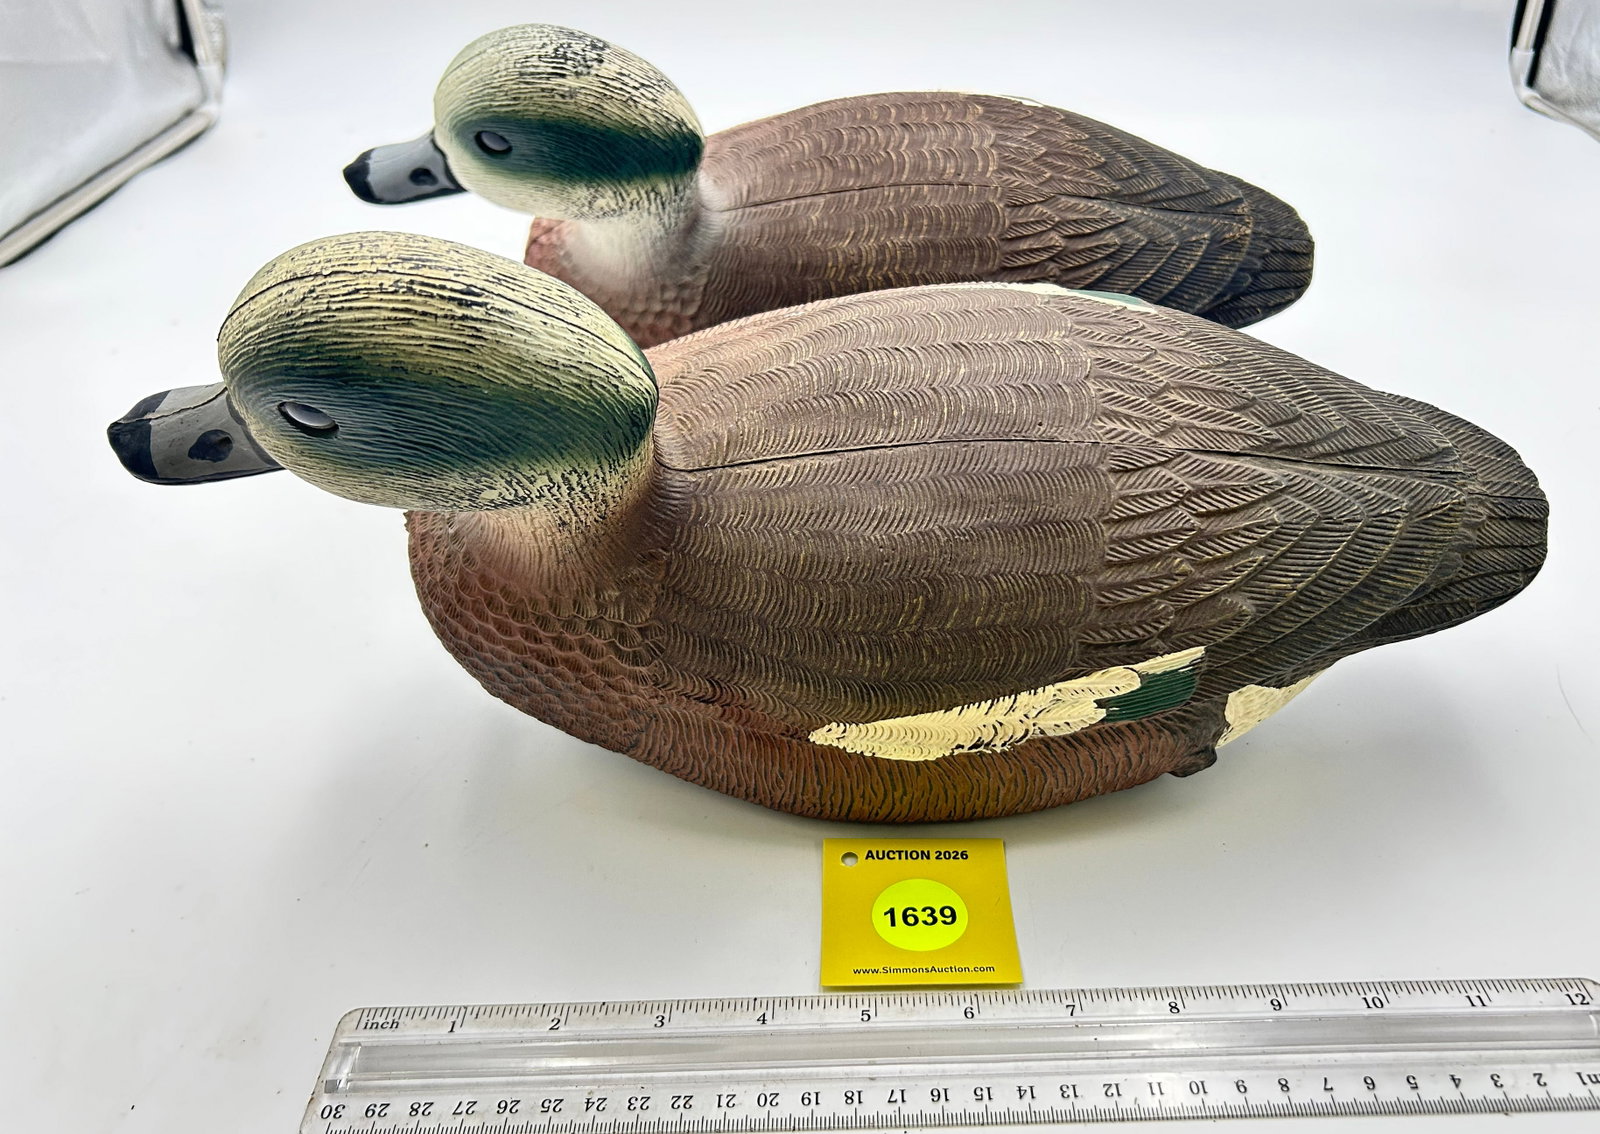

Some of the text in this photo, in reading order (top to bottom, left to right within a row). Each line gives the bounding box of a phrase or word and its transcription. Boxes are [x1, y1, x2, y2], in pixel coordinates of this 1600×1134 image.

[865, 850, 969, 860] AUCTION 2026
[883, 905, 957, 927] 1639
[853, 965, 995, 974] www.SimmonsAuction.com
[363, 993, 1590, 1033] inch 1 2 3 4 5 6 7 8 9 10 11 12
[1235, 1079, 1248, 1094] 9
[1278, 1077, 1290, 1092] 8
[1323, 1077, 1333, 1091] 7
[1363, 1076, 1376, 1090] 6
[1406, 1074, 1419, 1089] 5
[1449, 1074, 1462, 1089] 4
[1490, 1073, 1504, 1088] 3
[1533, 1072, 1547, 1087] 2
[930, 1087, 950, 1102] 16
[973, 1086, 993, 1100] 15
[1016, 1085, 1036, 1100] 14
[1060, 1084, 1079, 1098] 13
[1103, 1083, 1122, 1097] 12
[1149, 1082, 1166, 1096] 11
[1189, 1080, 1208, 1095] 10
[671, 1094, 694, 1109] 22
[716, 1093, 737, 1108] 21
[756, 1092, 779, 1107] 20
[801, 1091, 821, 1106] 19
[844, 1090, 863, 1104] 18
[887, 1088, 907, 1103] 17
[365, 1103, 391, 1117] 29
[409, 1101, 434, 1116] 28
[452, 1100, 478, 1115] 27
[497, 1100, 521, 1114] 26
[540, 1099, 564, 1113] 25
[584, 1097, 608, 1112] 24
[627, 1096, 651, 1111] 23
[321, 1104, 345, 1119] 30
